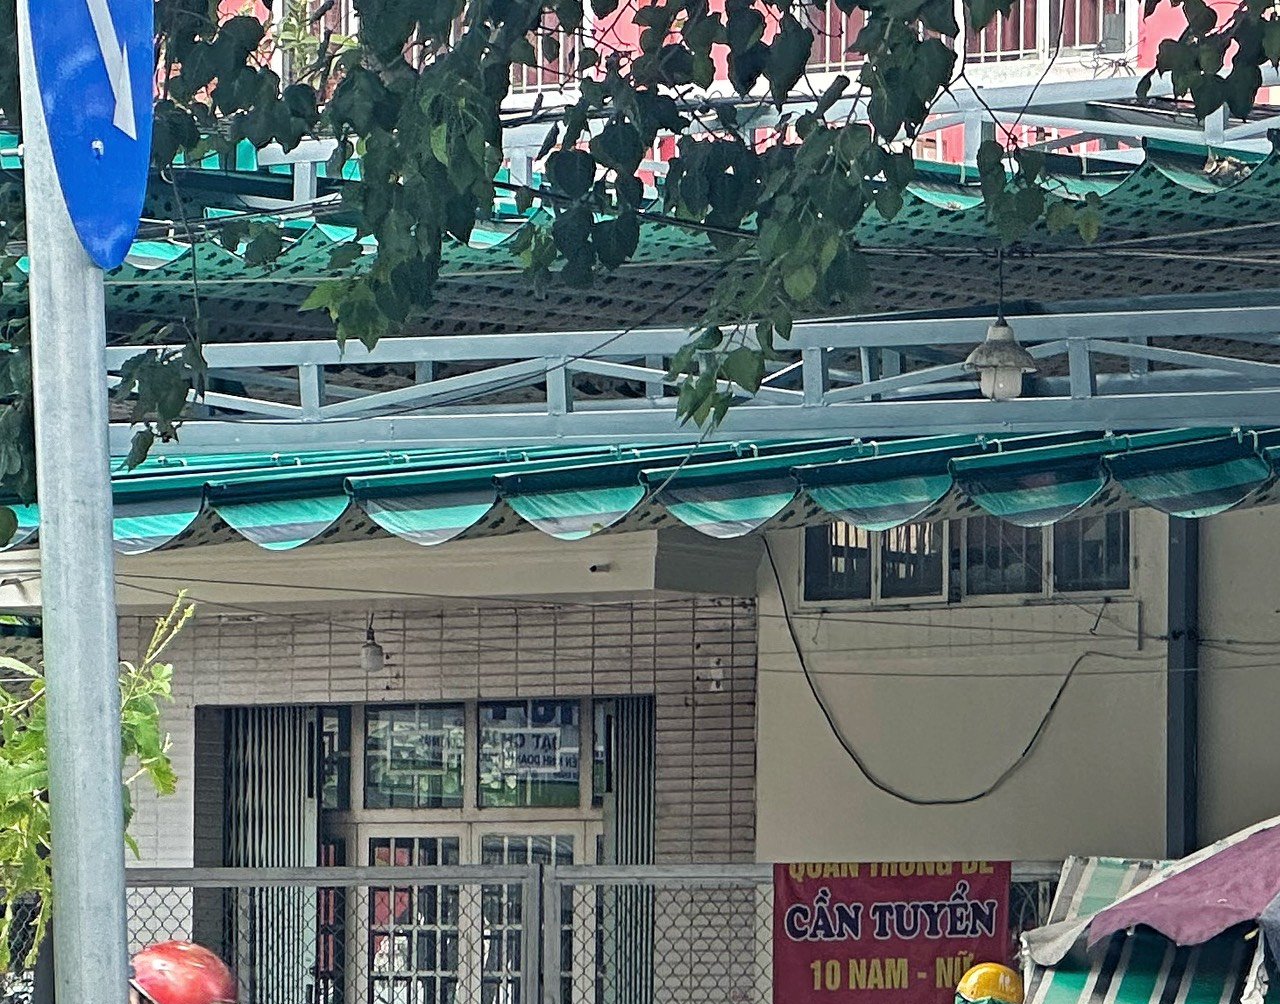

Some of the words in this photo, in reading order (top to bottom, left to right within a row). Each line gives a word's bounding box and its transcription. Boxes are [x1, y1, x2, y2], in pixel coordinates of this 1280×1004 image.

[785, 886, 862, 941] CẦN
[870, 879, 998, 940] TUYỂN
[810, 959, 840, 991] 10
[849, 958, 908, 990] NAM
